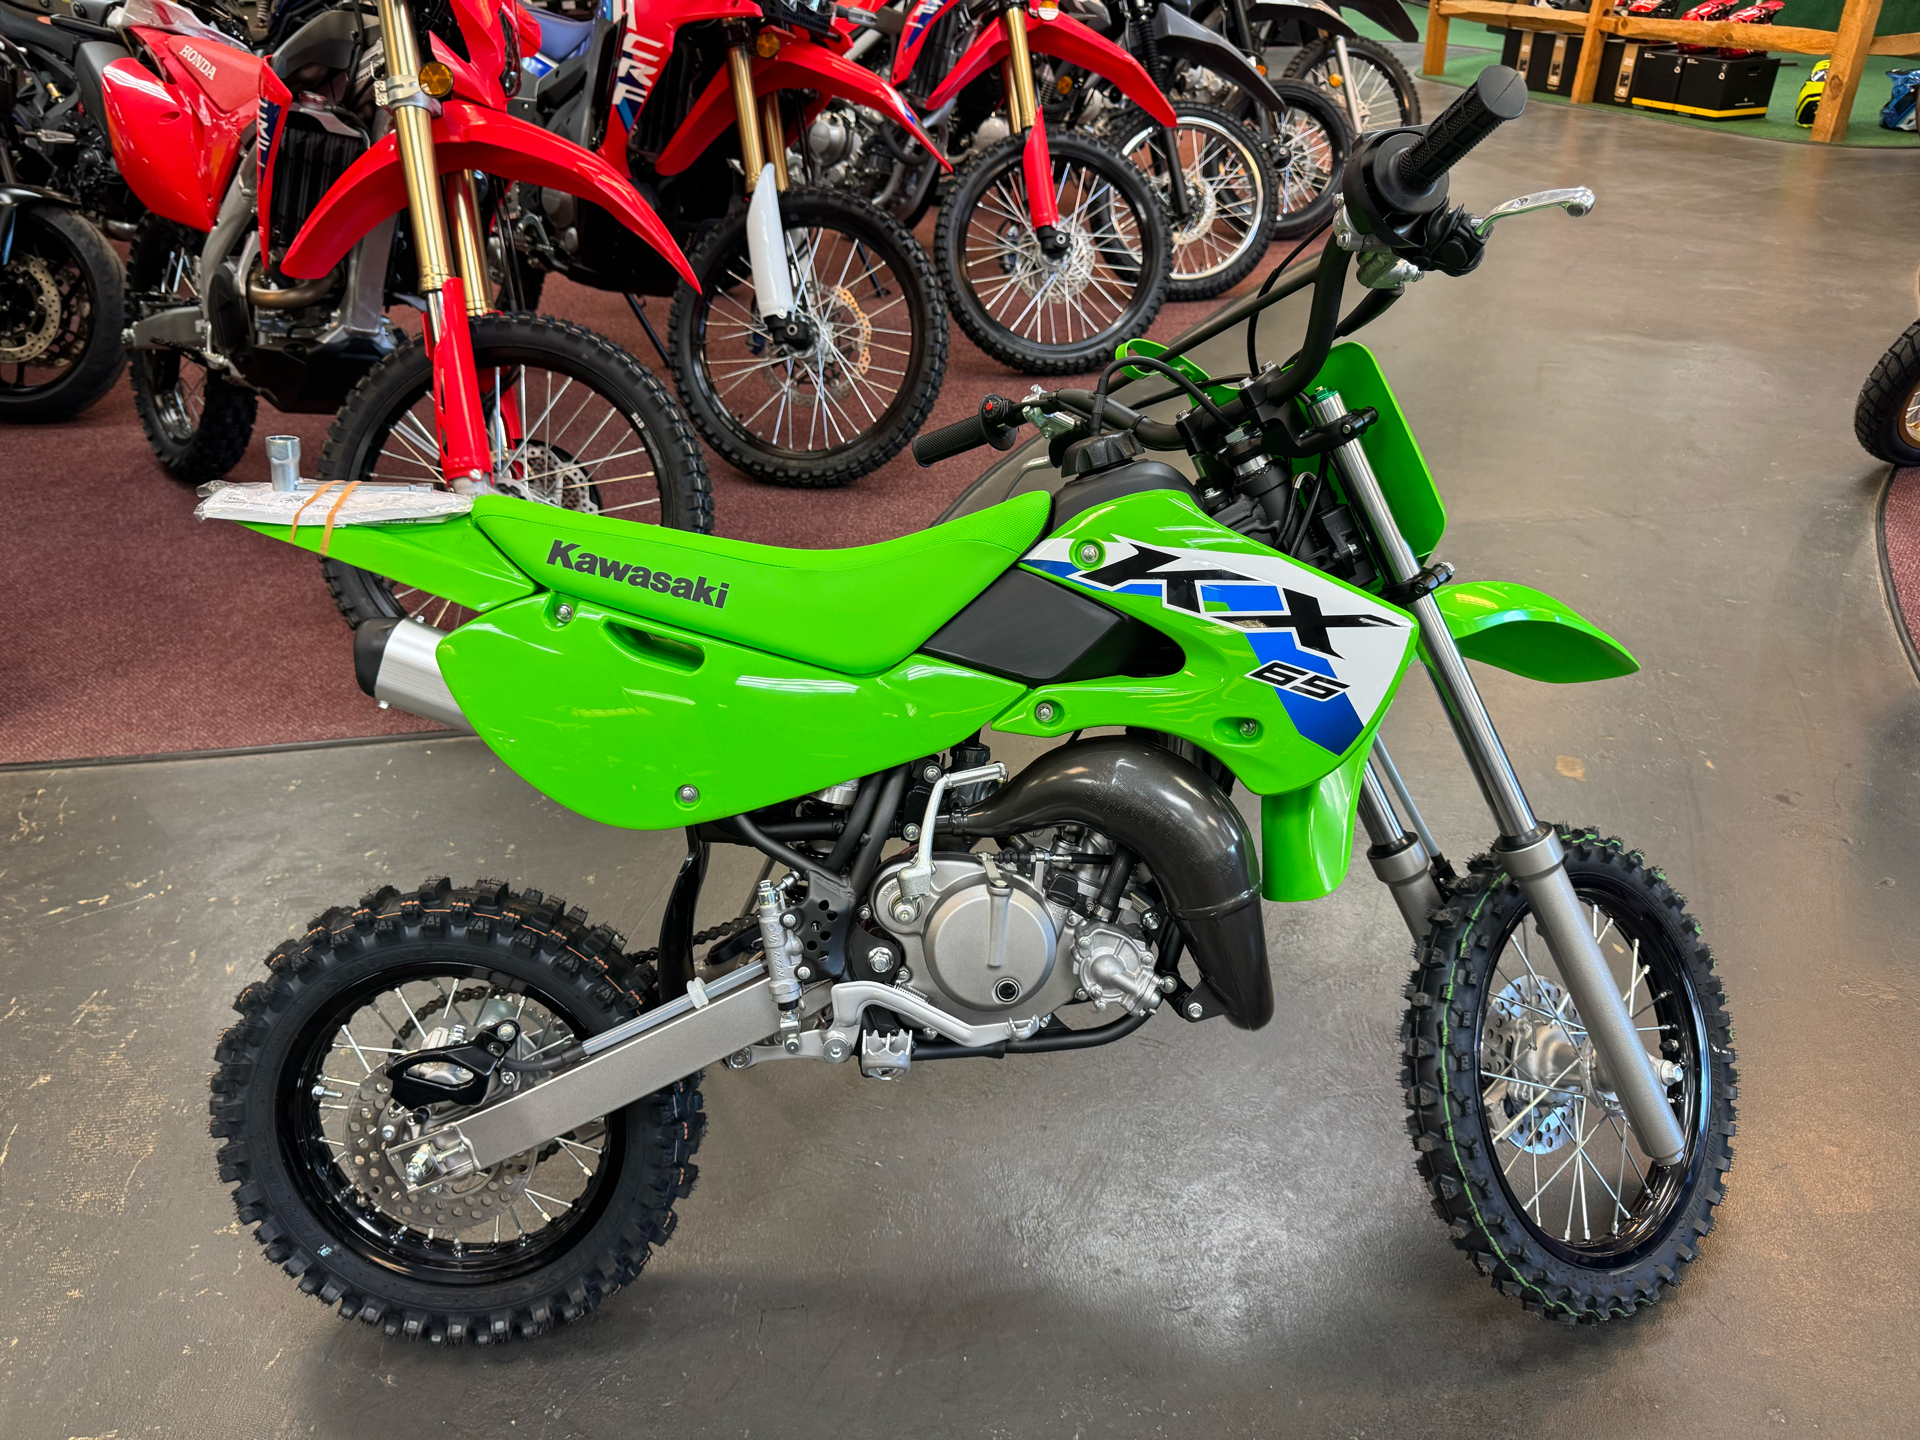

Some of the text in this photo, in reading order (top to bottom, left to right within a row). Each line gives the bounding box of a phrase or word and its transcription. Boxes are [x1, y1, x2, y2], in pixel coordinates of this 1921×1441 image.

[179, 45, 217, 80] HONDA
[546, 539, 730, 609] Kawasaki
[1077, 542, 1410, 660] KX
[1247, 659, 1351, 701] 65
